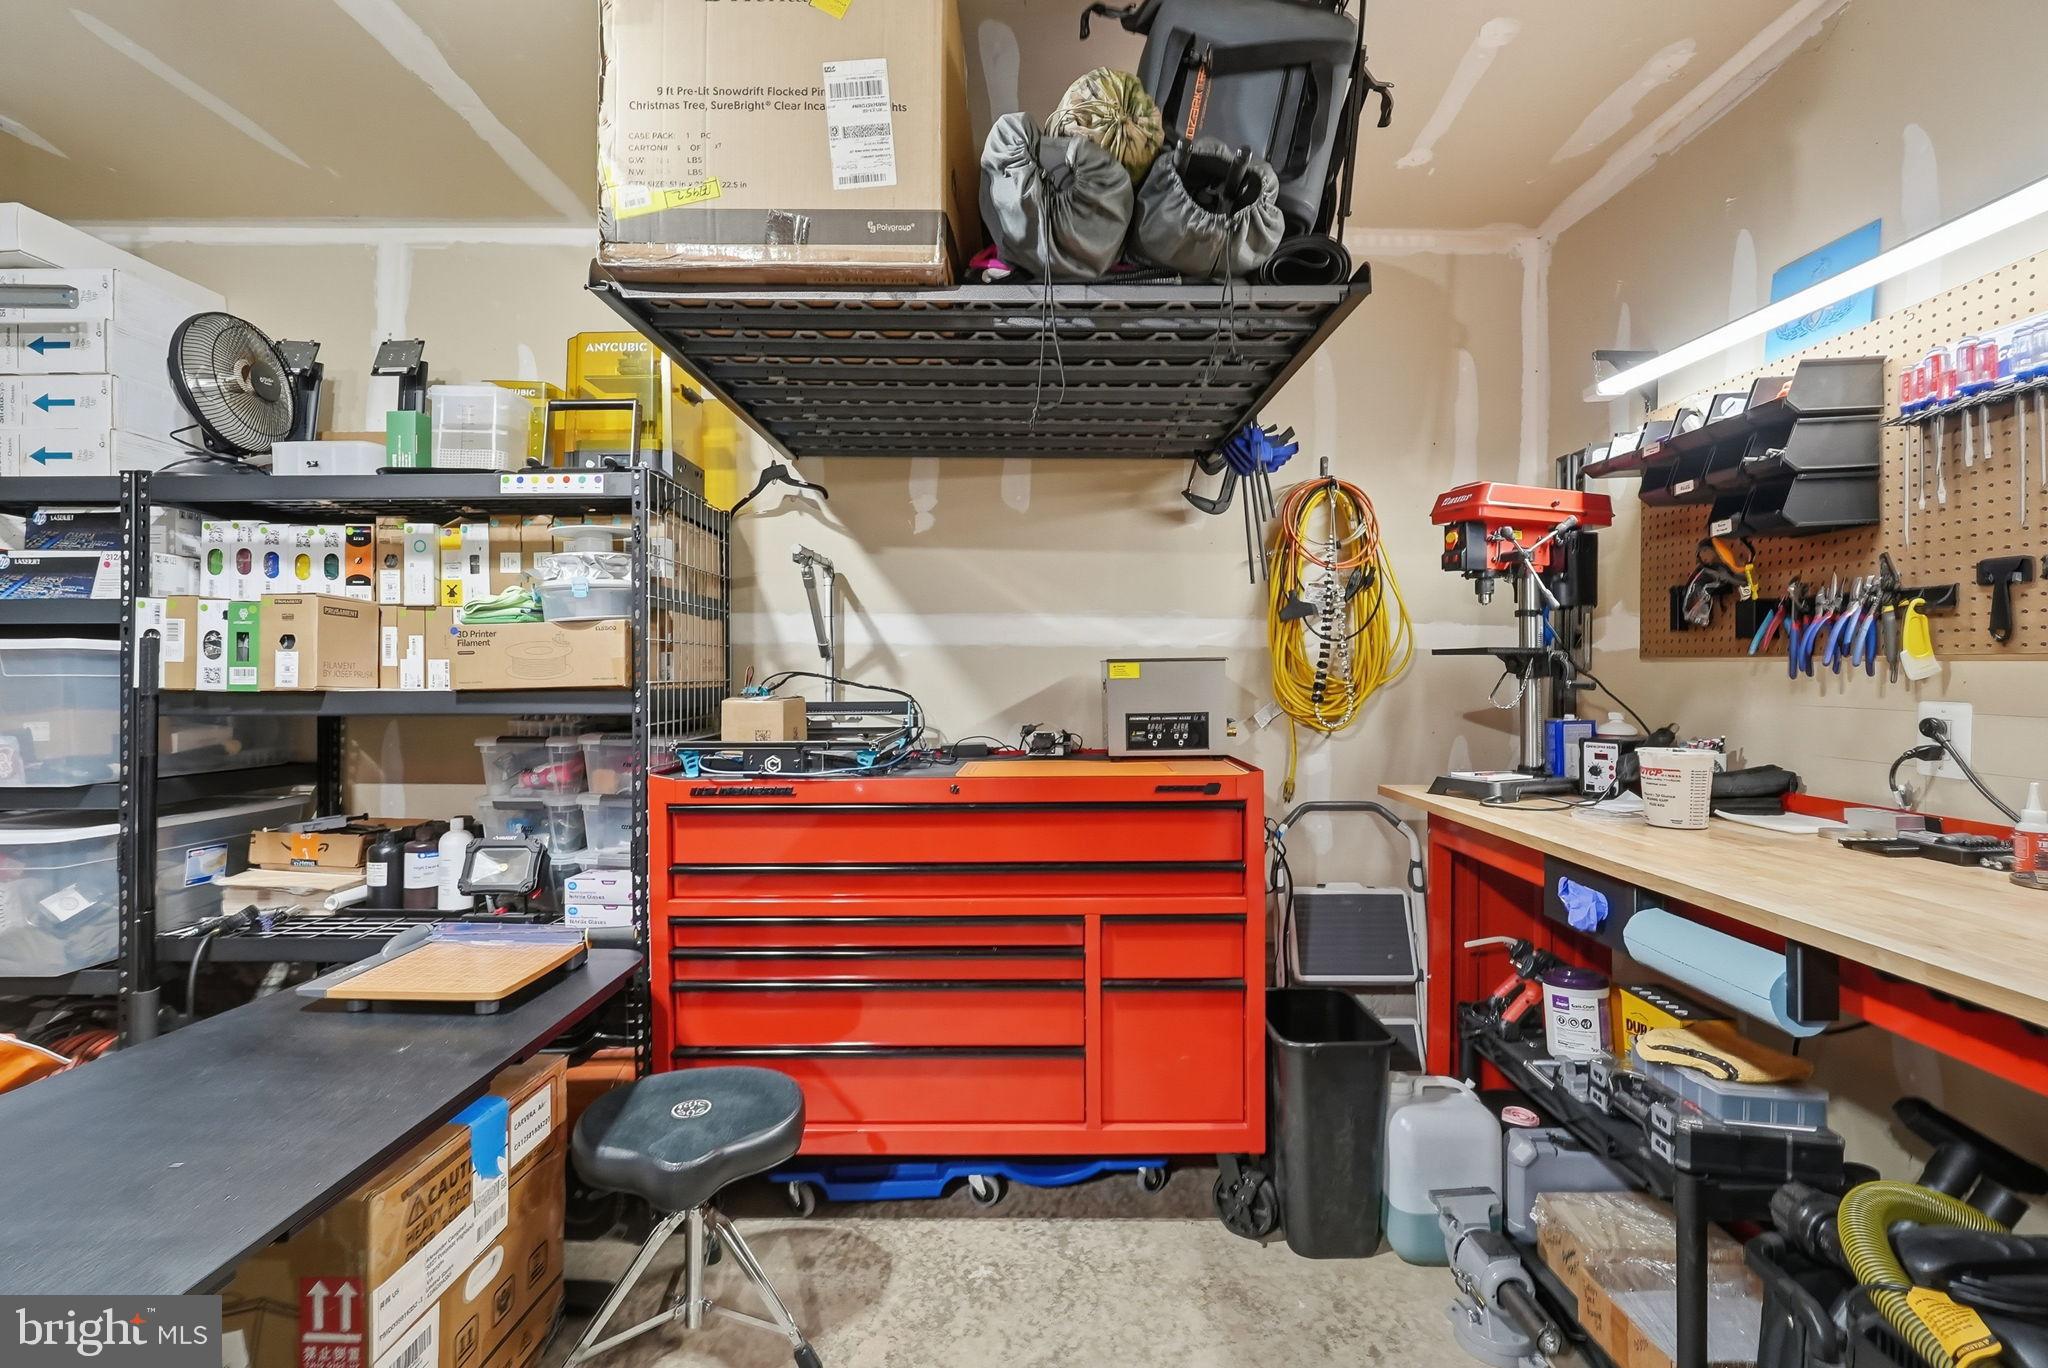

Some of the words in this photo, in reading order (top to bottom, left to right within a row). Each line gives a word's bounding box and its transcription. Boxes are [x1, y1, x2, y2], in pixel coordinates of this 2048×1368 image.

[656, 86, 664, 97] 9
[665, 86, 675, 97] ft
[677, 86, 710, 97] Pre-Lit
[712, 86, 765, 97] Snowdrift
[767, 86, 809, 97] Flocked
[628, 101, 680, 110] Christmas
[683, 101, 708, 112] Tree,
[773, 101, 801, 111] Clear
[803, 101, 826, 111] Inca
[891, 102, 908, 112] hts
[585, 342, 648, 353] ANYCUBIC
[457, 630, 469, 638] 3D
[469, 630, 497, 638] Printer
[457, 639, 491, 647] Filament
[1625, 1018, 1655, 1036] DUR
[428, 1157, 472, 1206] CAUTI
